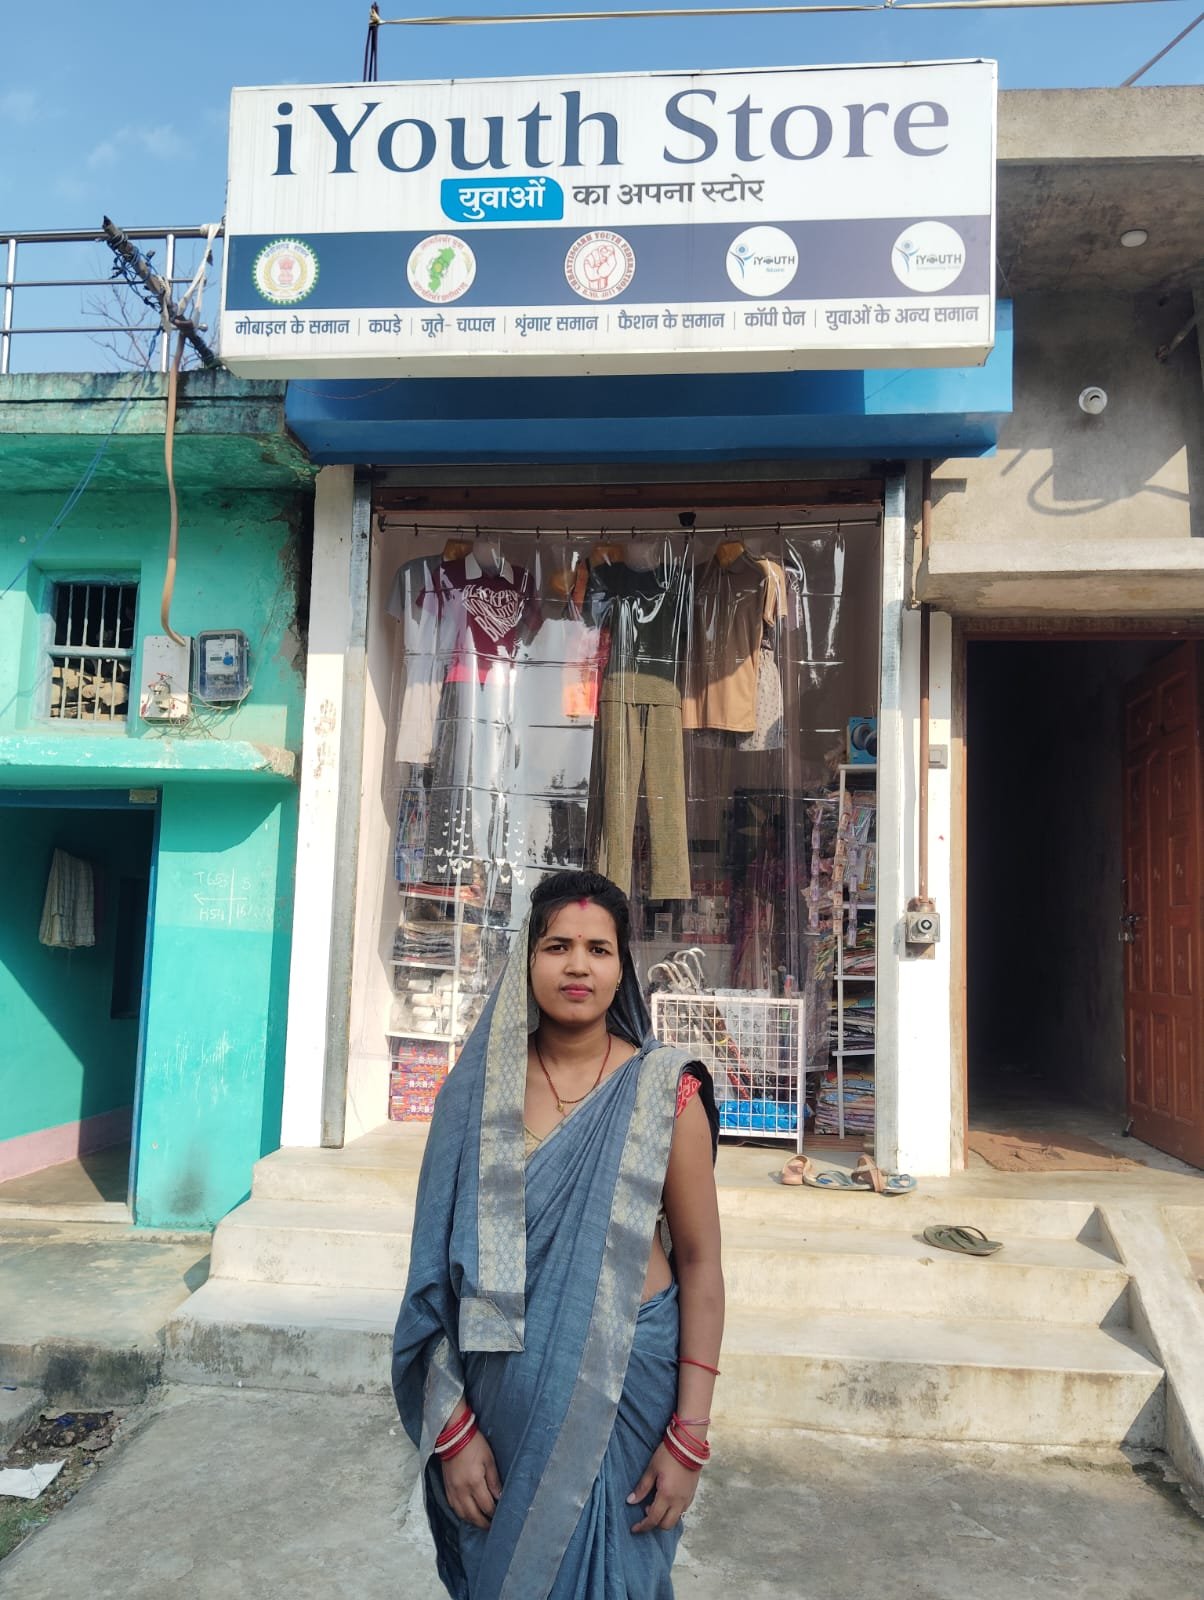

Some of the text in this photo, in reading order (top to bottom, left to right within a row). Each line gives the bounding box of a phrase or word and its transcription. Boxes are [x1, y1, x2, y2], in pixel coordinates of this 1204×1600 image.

[272, 88, 949, 176] iYouth Store
[459, 173, 765, 219] युवाओं का अपना स्टोर
[594, 232, 622, 244] YOUTH
[235, 316, 287, 337] मोबाइल
[290, 315, 306, 335] के
[309, 319, 351, 335] समान
[368, 314, 403, 336] कपड़े
[456, 317, 496, 333] चप्पल
[556, 316, 599, 332] समान
[618, 309, 659, 330] फैशन
[662, 309, 678, 329] के
[682, 313, 725, 329] समान
[744, 307, 778, 327] कॉपी
[782, 306, 806, 326] पेन
[825, 304, 872, 331] युवाओं
[874, 304, 891, 324] के
[895, 308, 930, 324] अन्य
[934, 306, 979, 322] समान
